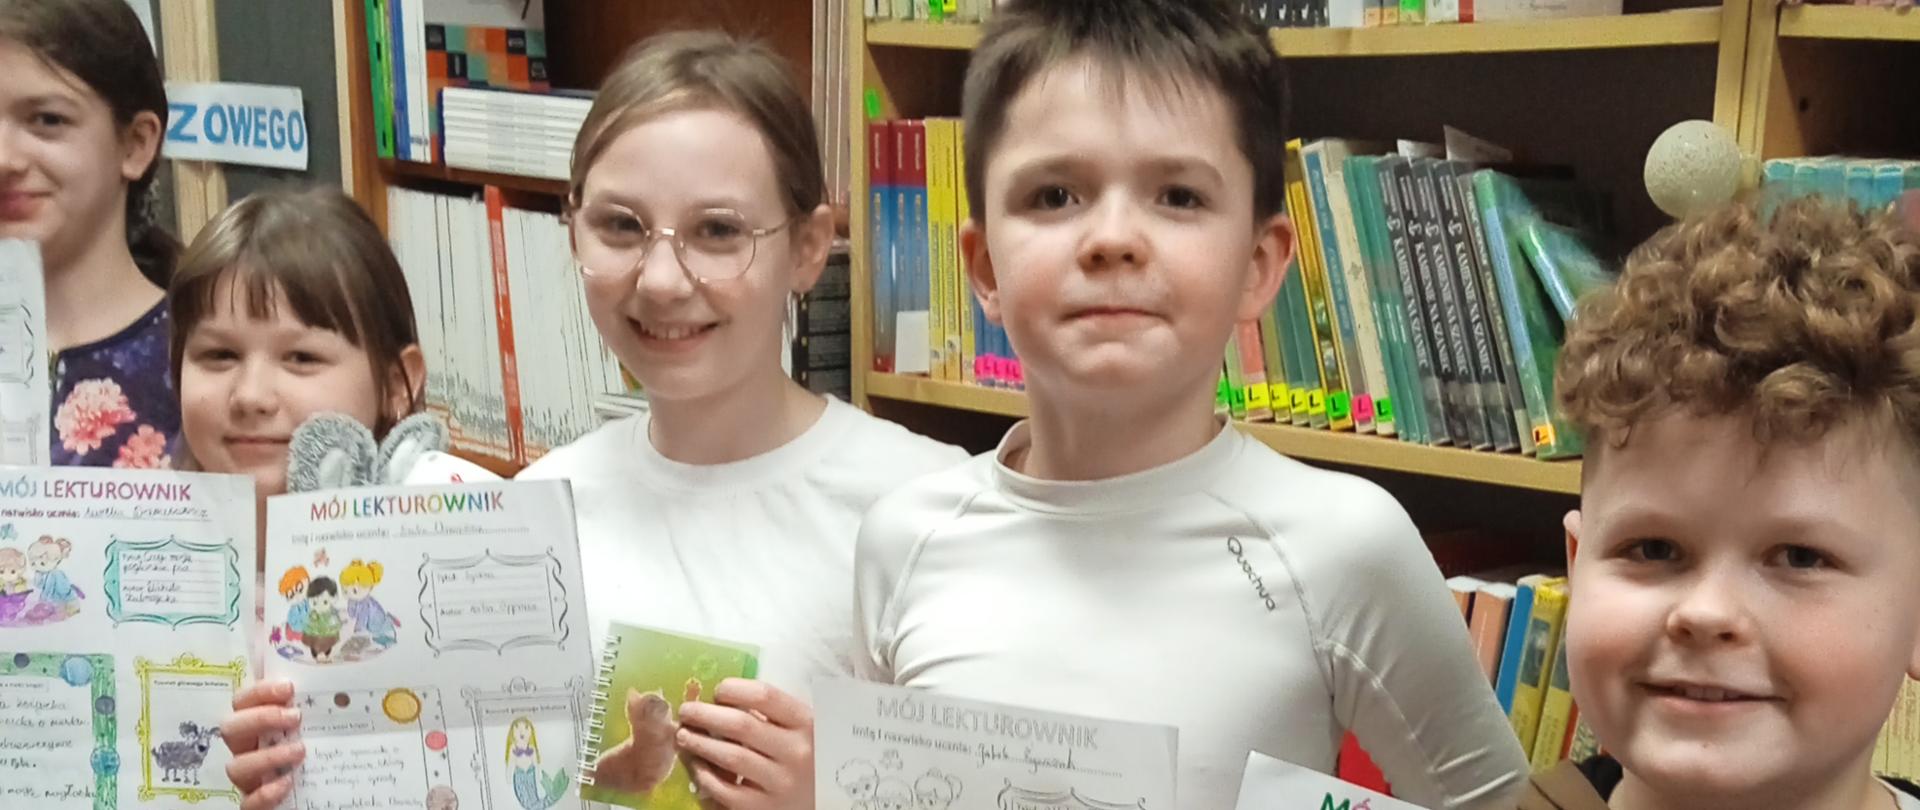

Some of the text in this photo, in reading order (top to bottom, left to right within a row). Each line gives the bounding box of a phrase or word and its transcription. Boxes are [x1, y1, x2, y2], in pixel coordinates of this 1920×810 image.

[1393, 237, 1414, 298] KAMIENIE
[1407, 299, 1417, 317] NA
[1415, 242, 1452, 373] KAMIENIE NA SZANIEC
[1432, 244, 1469, 375] KAMIENIE NA SZANIEC
[1455, 242, 1492, 375] KAMIENIE NA SZANIEC
[1411, 317, 1428, 368] SZANIEC
[44, 480, 191, 502] LEKTUROWNIK
[310, 490, 504, 521] MÓJ LEKTUROWNIK
[877, 696, 1098, 750] MÓJ LEKTUROWNIK
